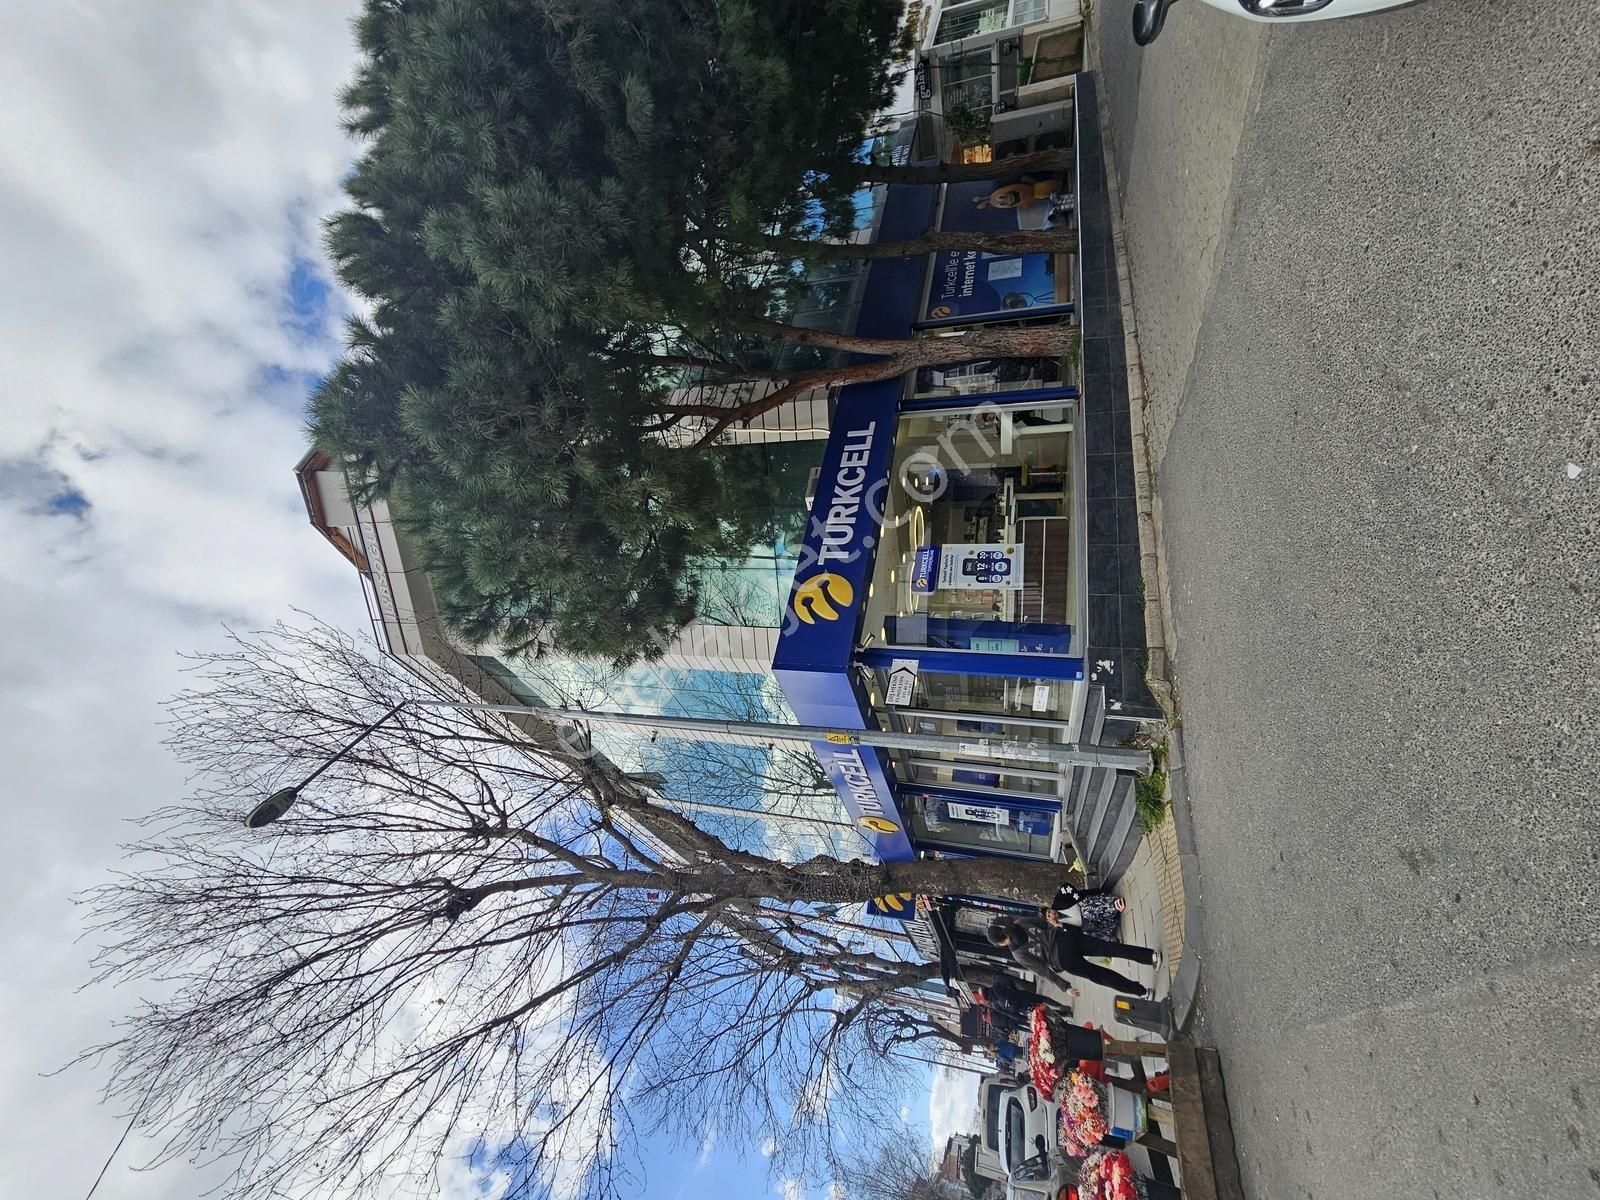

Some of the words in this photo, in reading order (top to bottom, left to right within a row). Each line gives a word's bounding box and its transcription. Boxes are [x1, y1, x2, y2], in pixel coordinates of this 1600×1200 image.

[917, 62, 931, 99] gelato
[963, 251, 977, 259] ke
[941, 258, 959, 299] Turkcell'le
[958, 261, 976, 297] internet
[817, 421, 877, 566] TURKCELL
[920, 550, 929, 578] TURKCELL
[977, 563, 985, 571] 12
[833, 749, 884, 815] TURKCELL
[1028, 927, 1036, 955] ATA
